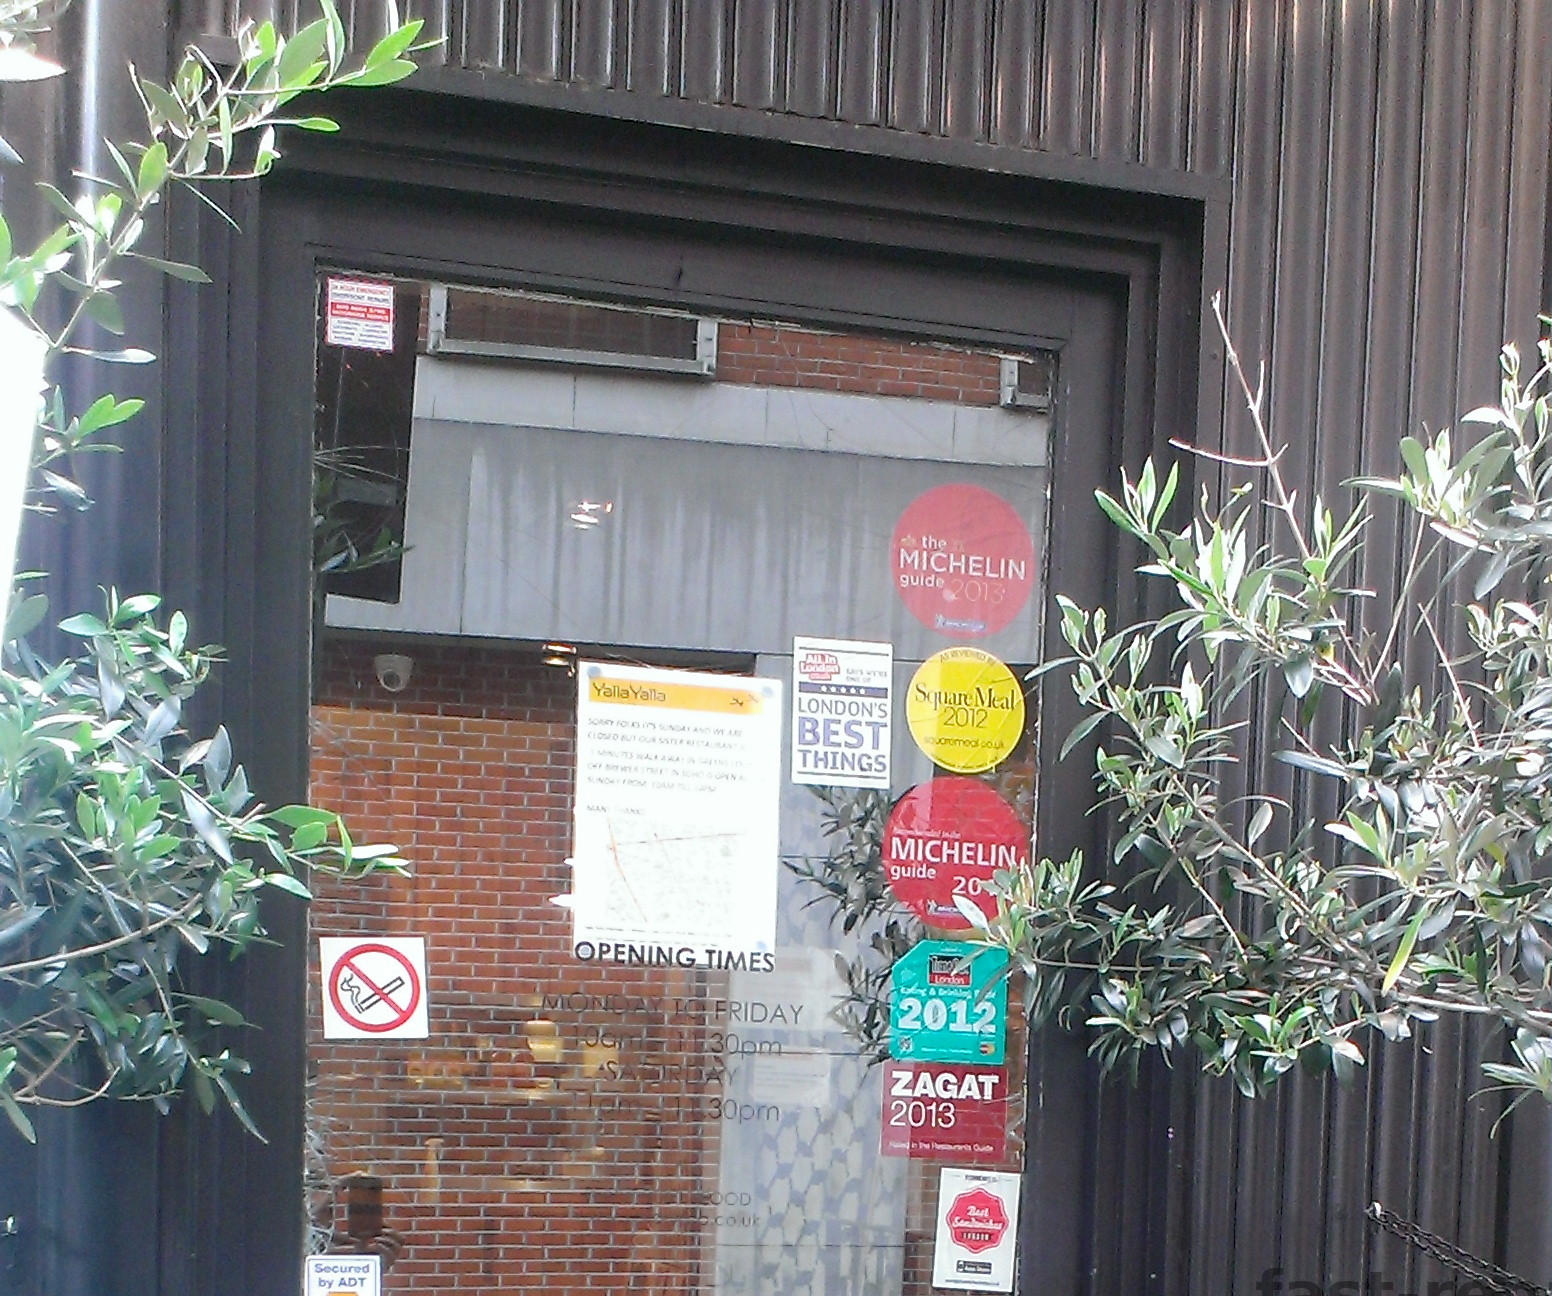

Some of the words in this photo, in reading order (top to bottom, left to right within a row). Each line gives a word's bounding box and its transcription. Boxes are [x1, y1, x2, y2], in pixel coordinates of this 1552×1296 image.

[921, 535, 948, 550] the
[900, 548, 1027, 580] MICHELIN
[900, 574, 945, 588] guide
[951, 579, 1006, 604] 2013
[801, 662, 840, 674] London
[805, 654, 823, 665] All
[798, 697, 889, 719] LONDON'S
[943, 706, 989, 730] 2012
[798, 716, 889, 751] BEST
[797, 749, 888, 774] THINGS
[890, 836, 1017, 867] MICHELIN
[890, 863, 937, 880] guide
[575, 940, 697, 968] OPENING
[705, 948, 776, 973] TIMES
[934, 975, 966, 985] London
[540, 992, 663, 1015] MONDAY
[715, 1000, 804, 1025] FRIDAY
[898, 996, 997, 1034] 2012
[604, 1060, 739, 1087] SAURDAY
[890, 1069, 1000, 1101] ZAGAT
[889, 1100, 956, 1129] 2013
[314, 1263, 371, 1274] Secured
[318, 1277, 334, 1289] by
[338, 1277, 368, 1288] ADT
